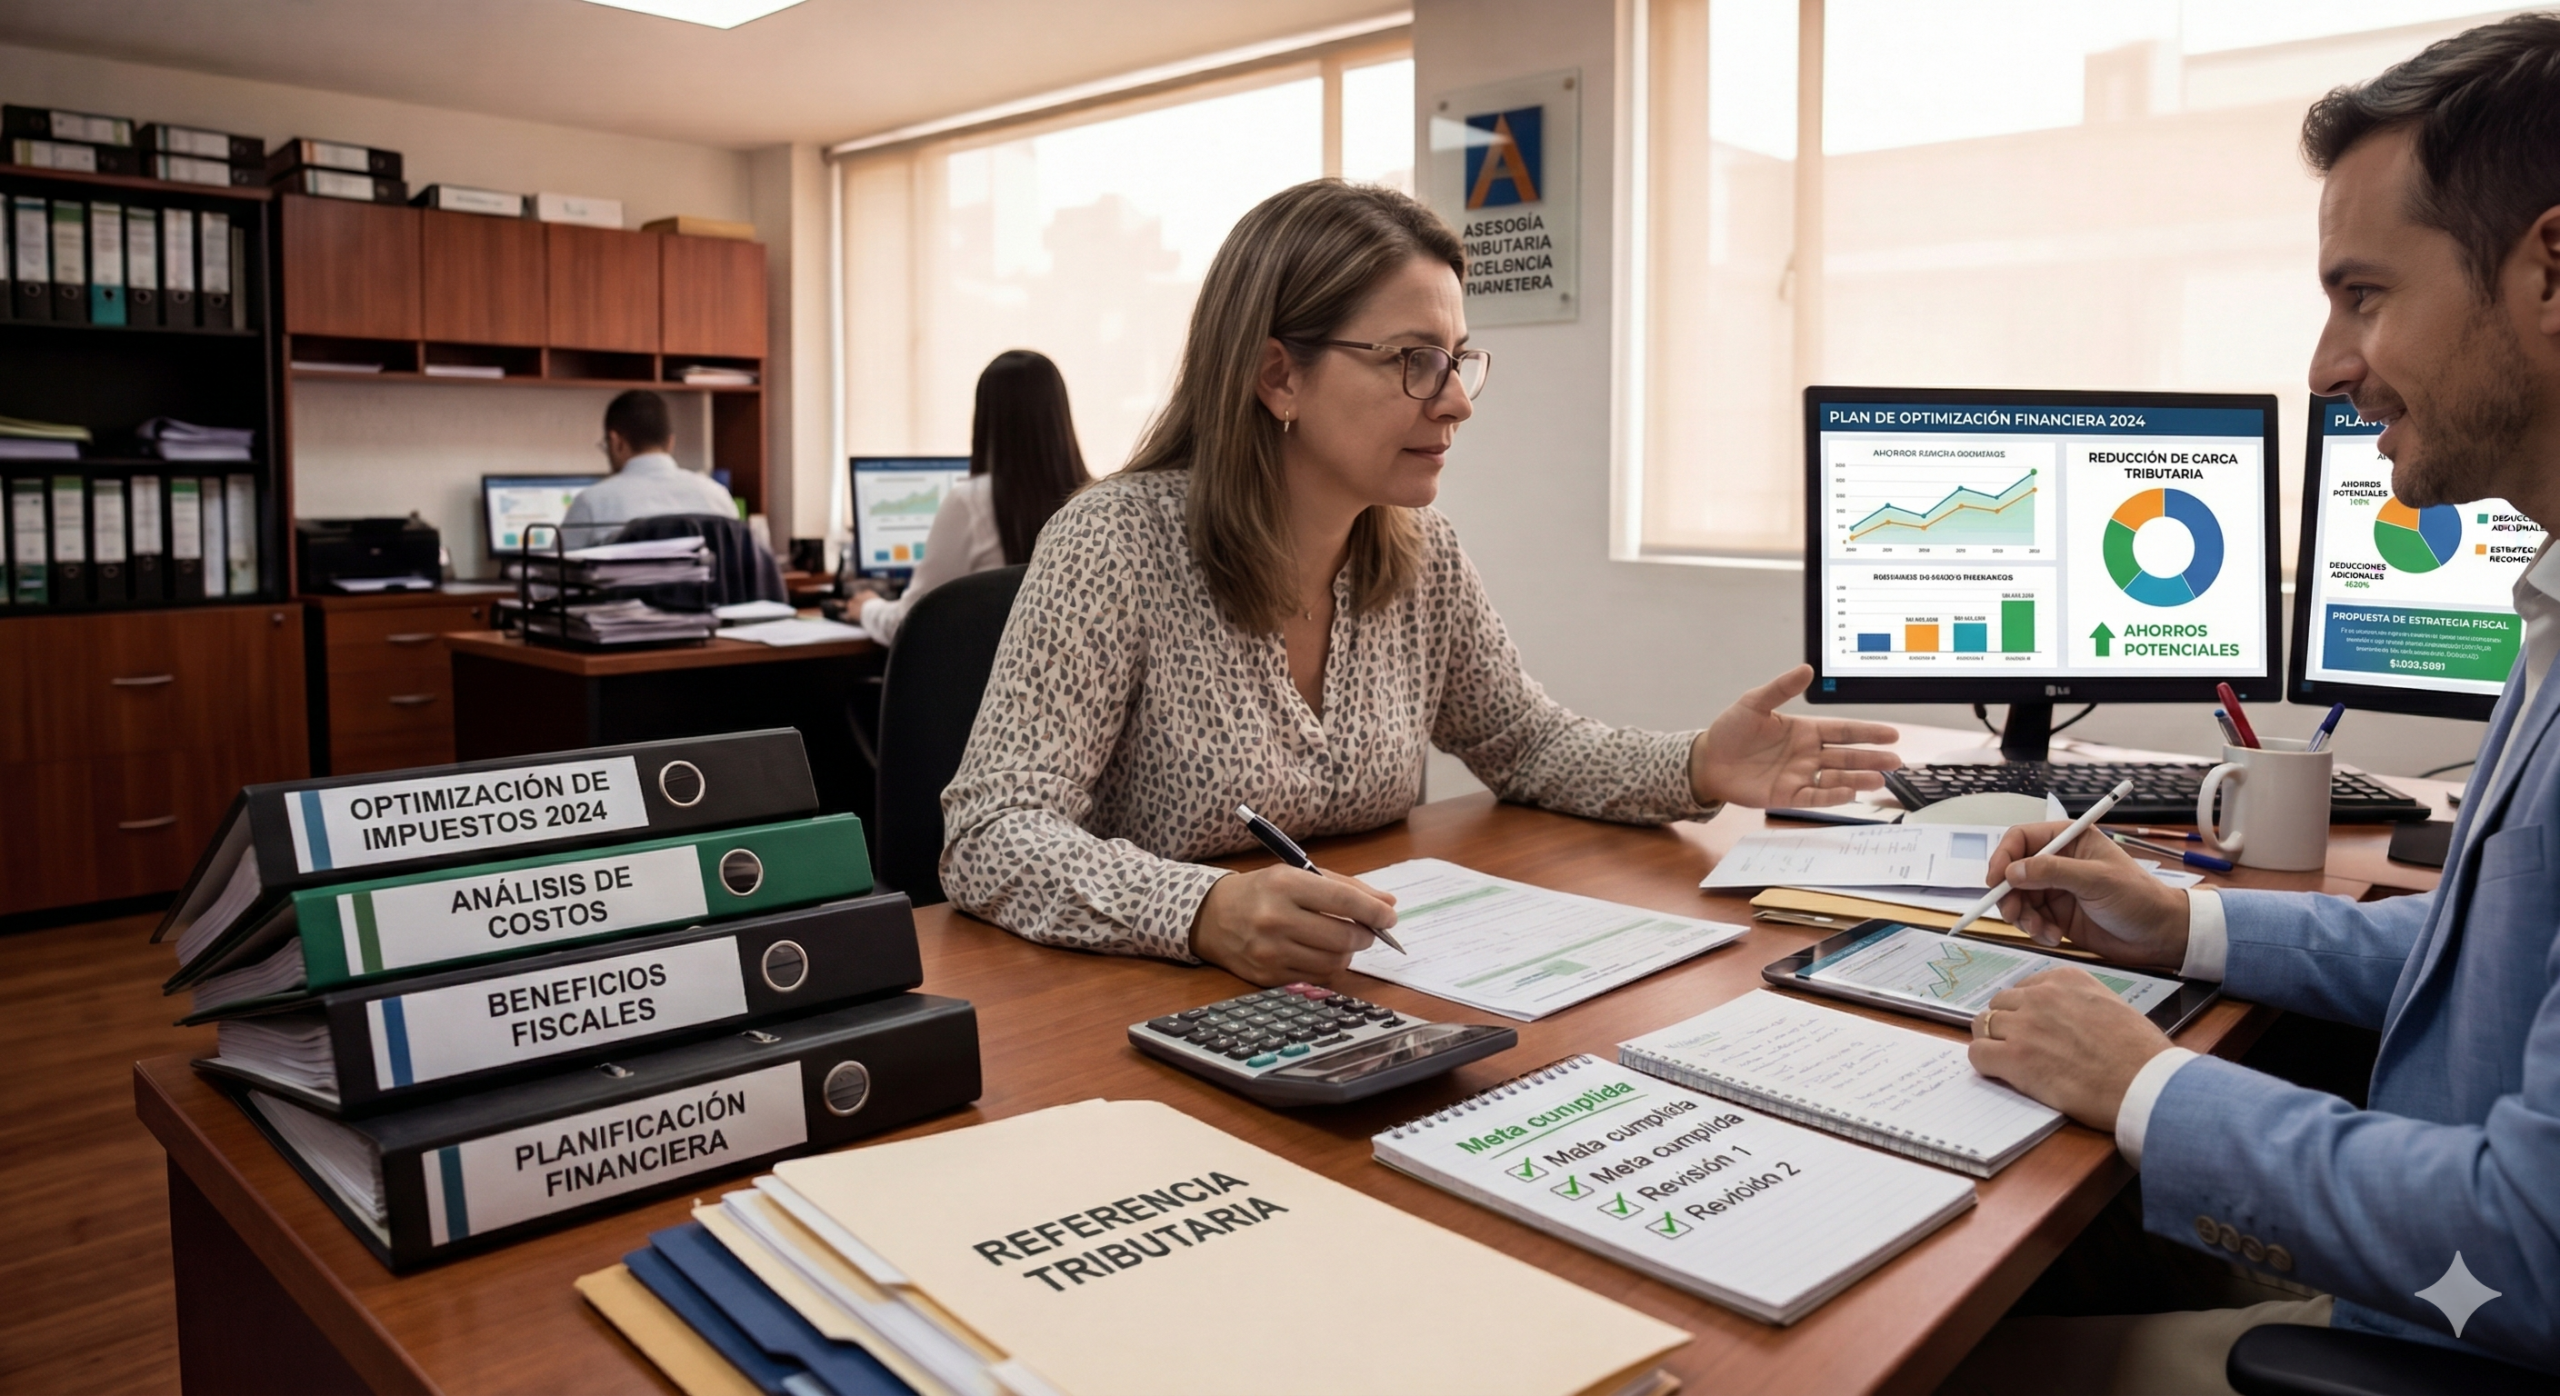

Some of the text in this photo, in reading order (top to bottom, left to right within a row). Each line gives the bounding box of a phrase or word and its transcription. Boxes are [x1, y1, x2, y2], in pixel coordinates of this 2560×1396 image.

[1829, 410, 2147, 427] PLAN DE OPTIMIZACIÓN FINANCIERA 2024
[2088, 450, 2167, 464] REDUCCIÓN
[2171, 453, 2189, 464] DE
[2124, 468, 2204, 480] TRIBUTARIA
[2329, 562, 2387, 571] DEDUCCIONES
[2331, 571, 2385, 580] ADICIONALES
[2123, 624, 2208, 638] AHORROS
[2332, 611, 2510, 630] PROPUESTA DE ESTRATEGIA FISCAL
[2124, 643, 2240, 657] POTENCIALES
[350, 770, 610, 820] OPTIMIZACIÓN DE
[363, 800, 608, 850] IMPUESTOS 2024
[451, 866, 633, 914] ANÁLISIS DE
[488, 900, 608, 939] COSTOS
[488, 963, 667, 1017] BENEFICIOS
[511, 997, 656, 1047] FISCALES
[515, 1090, 746, 1171] PLANIFICACIÓN
[1455, 1125, 1529, 1154] Meta
[546, 1129, 729, 1197] FINANCIERA
[1731, 1145, 1752, 1157] 1
[1589, 1154, 1654, 1186] Meta
[1775, 1161, 1802, 1177] 2
[972, 1171, 1250, 1267] REFERENCIA
[1022, 1197, 1290, 1292] TRIBUTARIA
